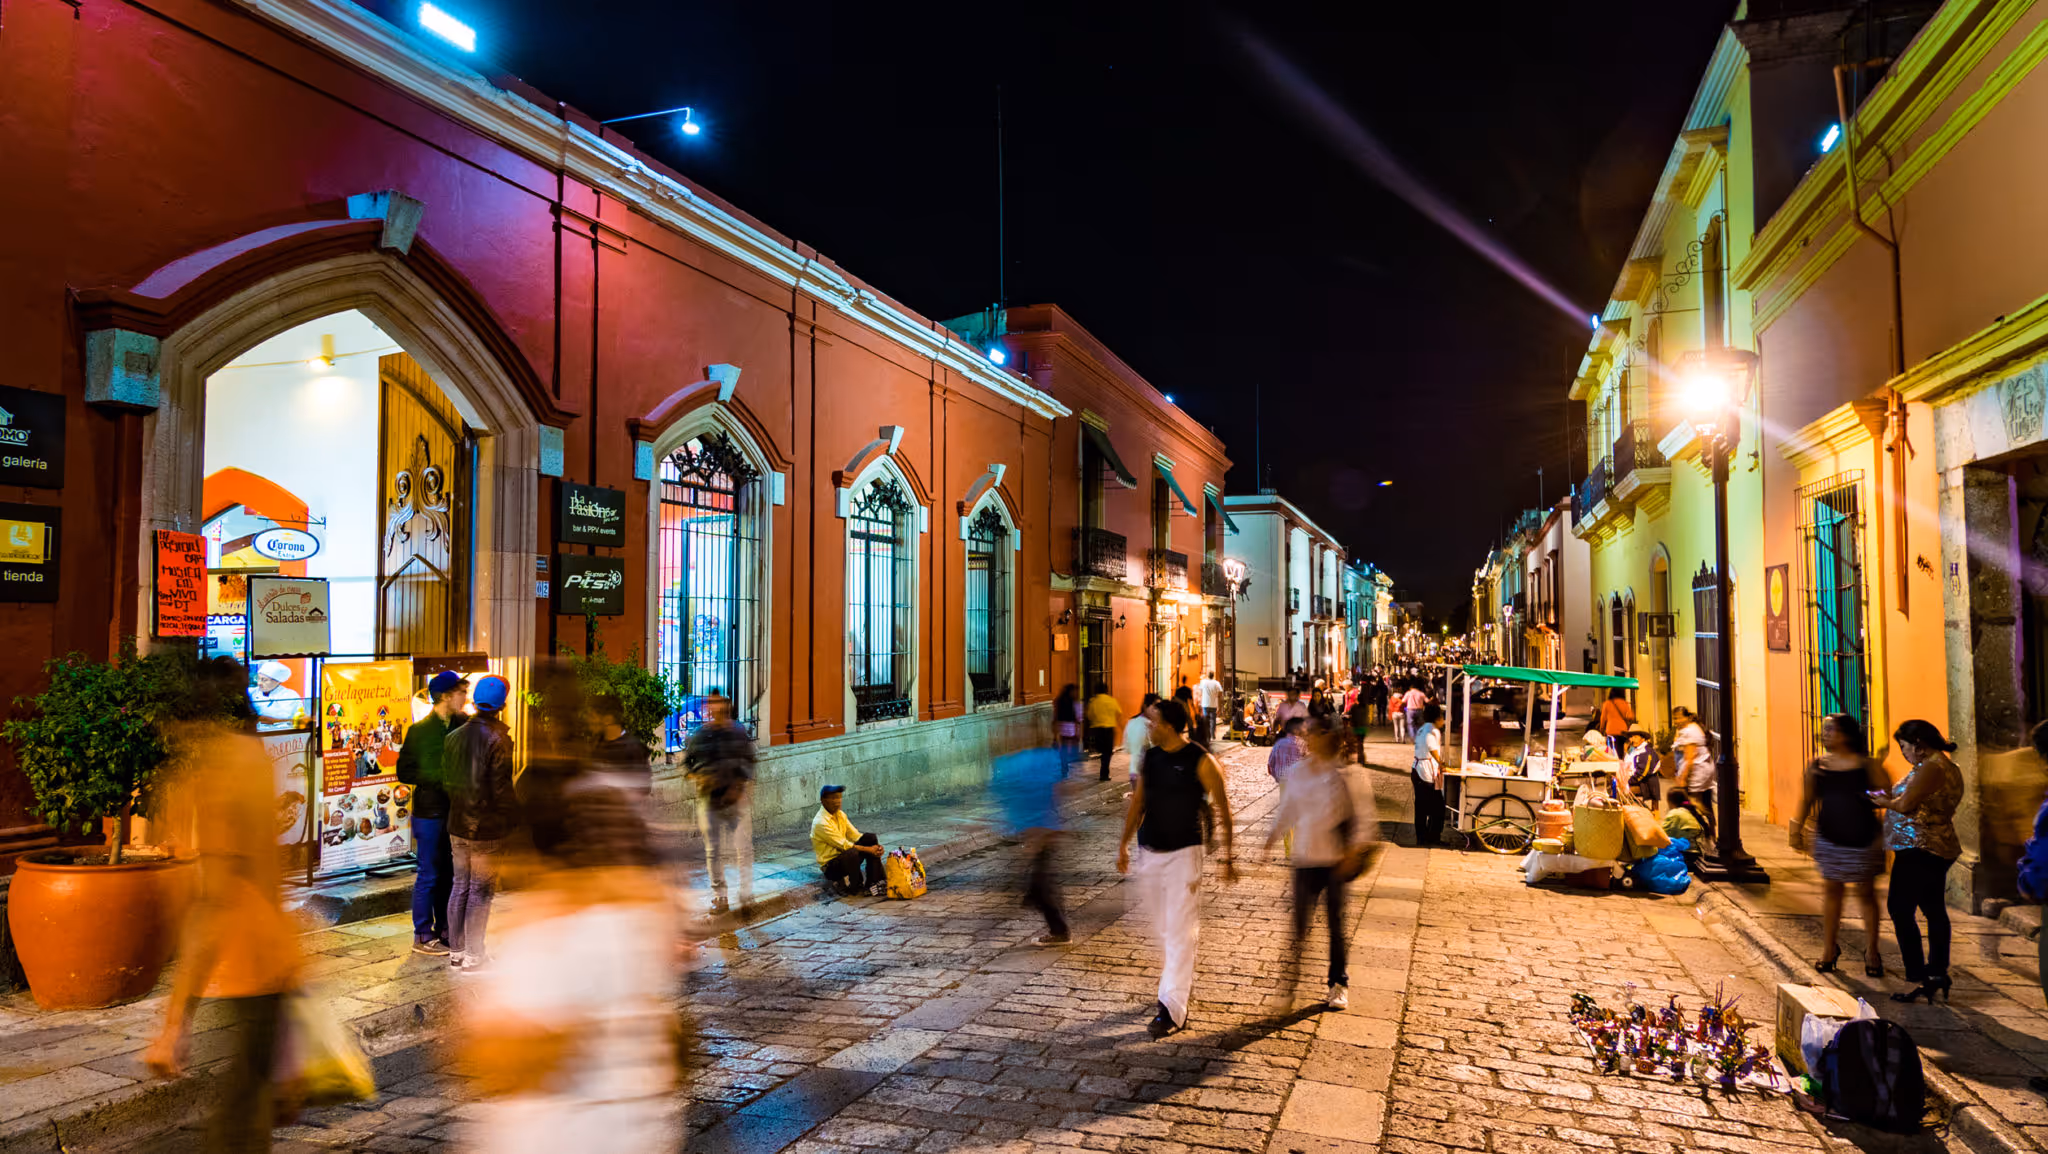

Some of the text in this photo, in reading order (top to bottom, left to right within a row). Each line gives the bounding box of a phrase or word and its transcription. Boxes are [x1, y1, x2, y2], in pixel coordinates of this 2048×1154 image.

[3, 455, 48, 470] galería
[267, 538, 305, 552] Corona
[4, 569, 44, 582] tienda
[583, 570, 608, 578] Super
[272, 601, 301, 612] Dulces
[265, 611, 305, 624] Saladas
[324, 684, 392, 704] Guelaguetza
